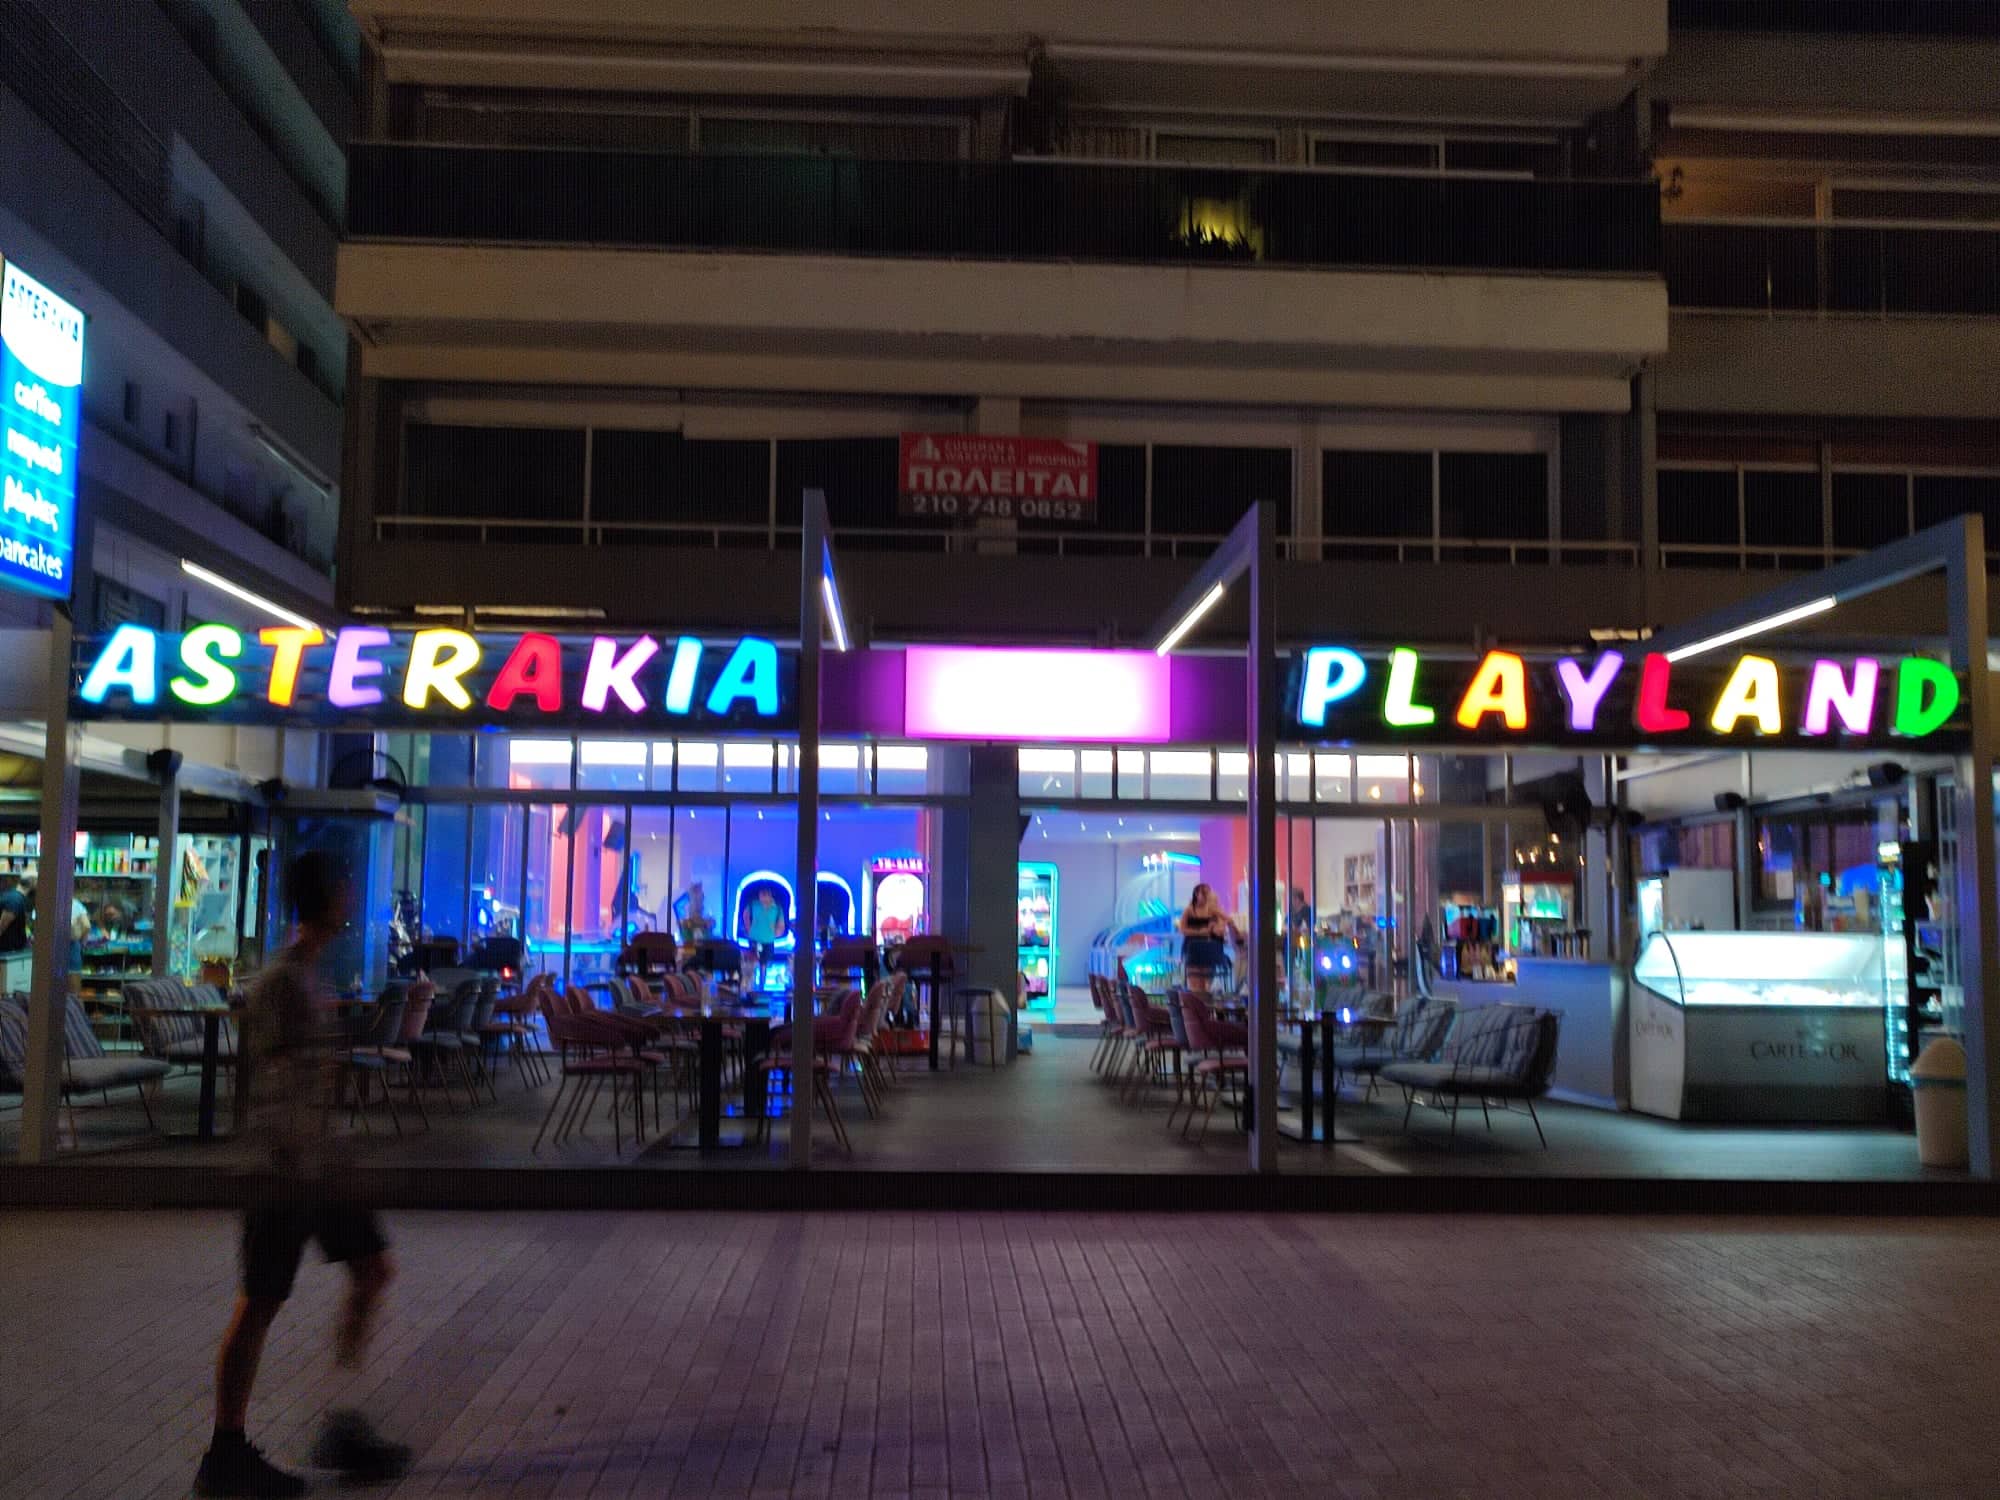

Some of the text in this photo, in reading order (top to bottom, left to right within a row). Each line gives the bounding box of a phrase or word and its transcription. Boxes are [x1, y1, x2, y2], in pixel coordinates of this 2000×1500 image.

[908, 466, 1089, 497] ΠΩΛΕΙΤΑΙ
[912, 495, 959, 514] 210
[967, 496, 1012, 517] 748
[80, 622, 779, 716] ASTERAKIA
[1301, 646, 1960, 737] PLAYLAND
